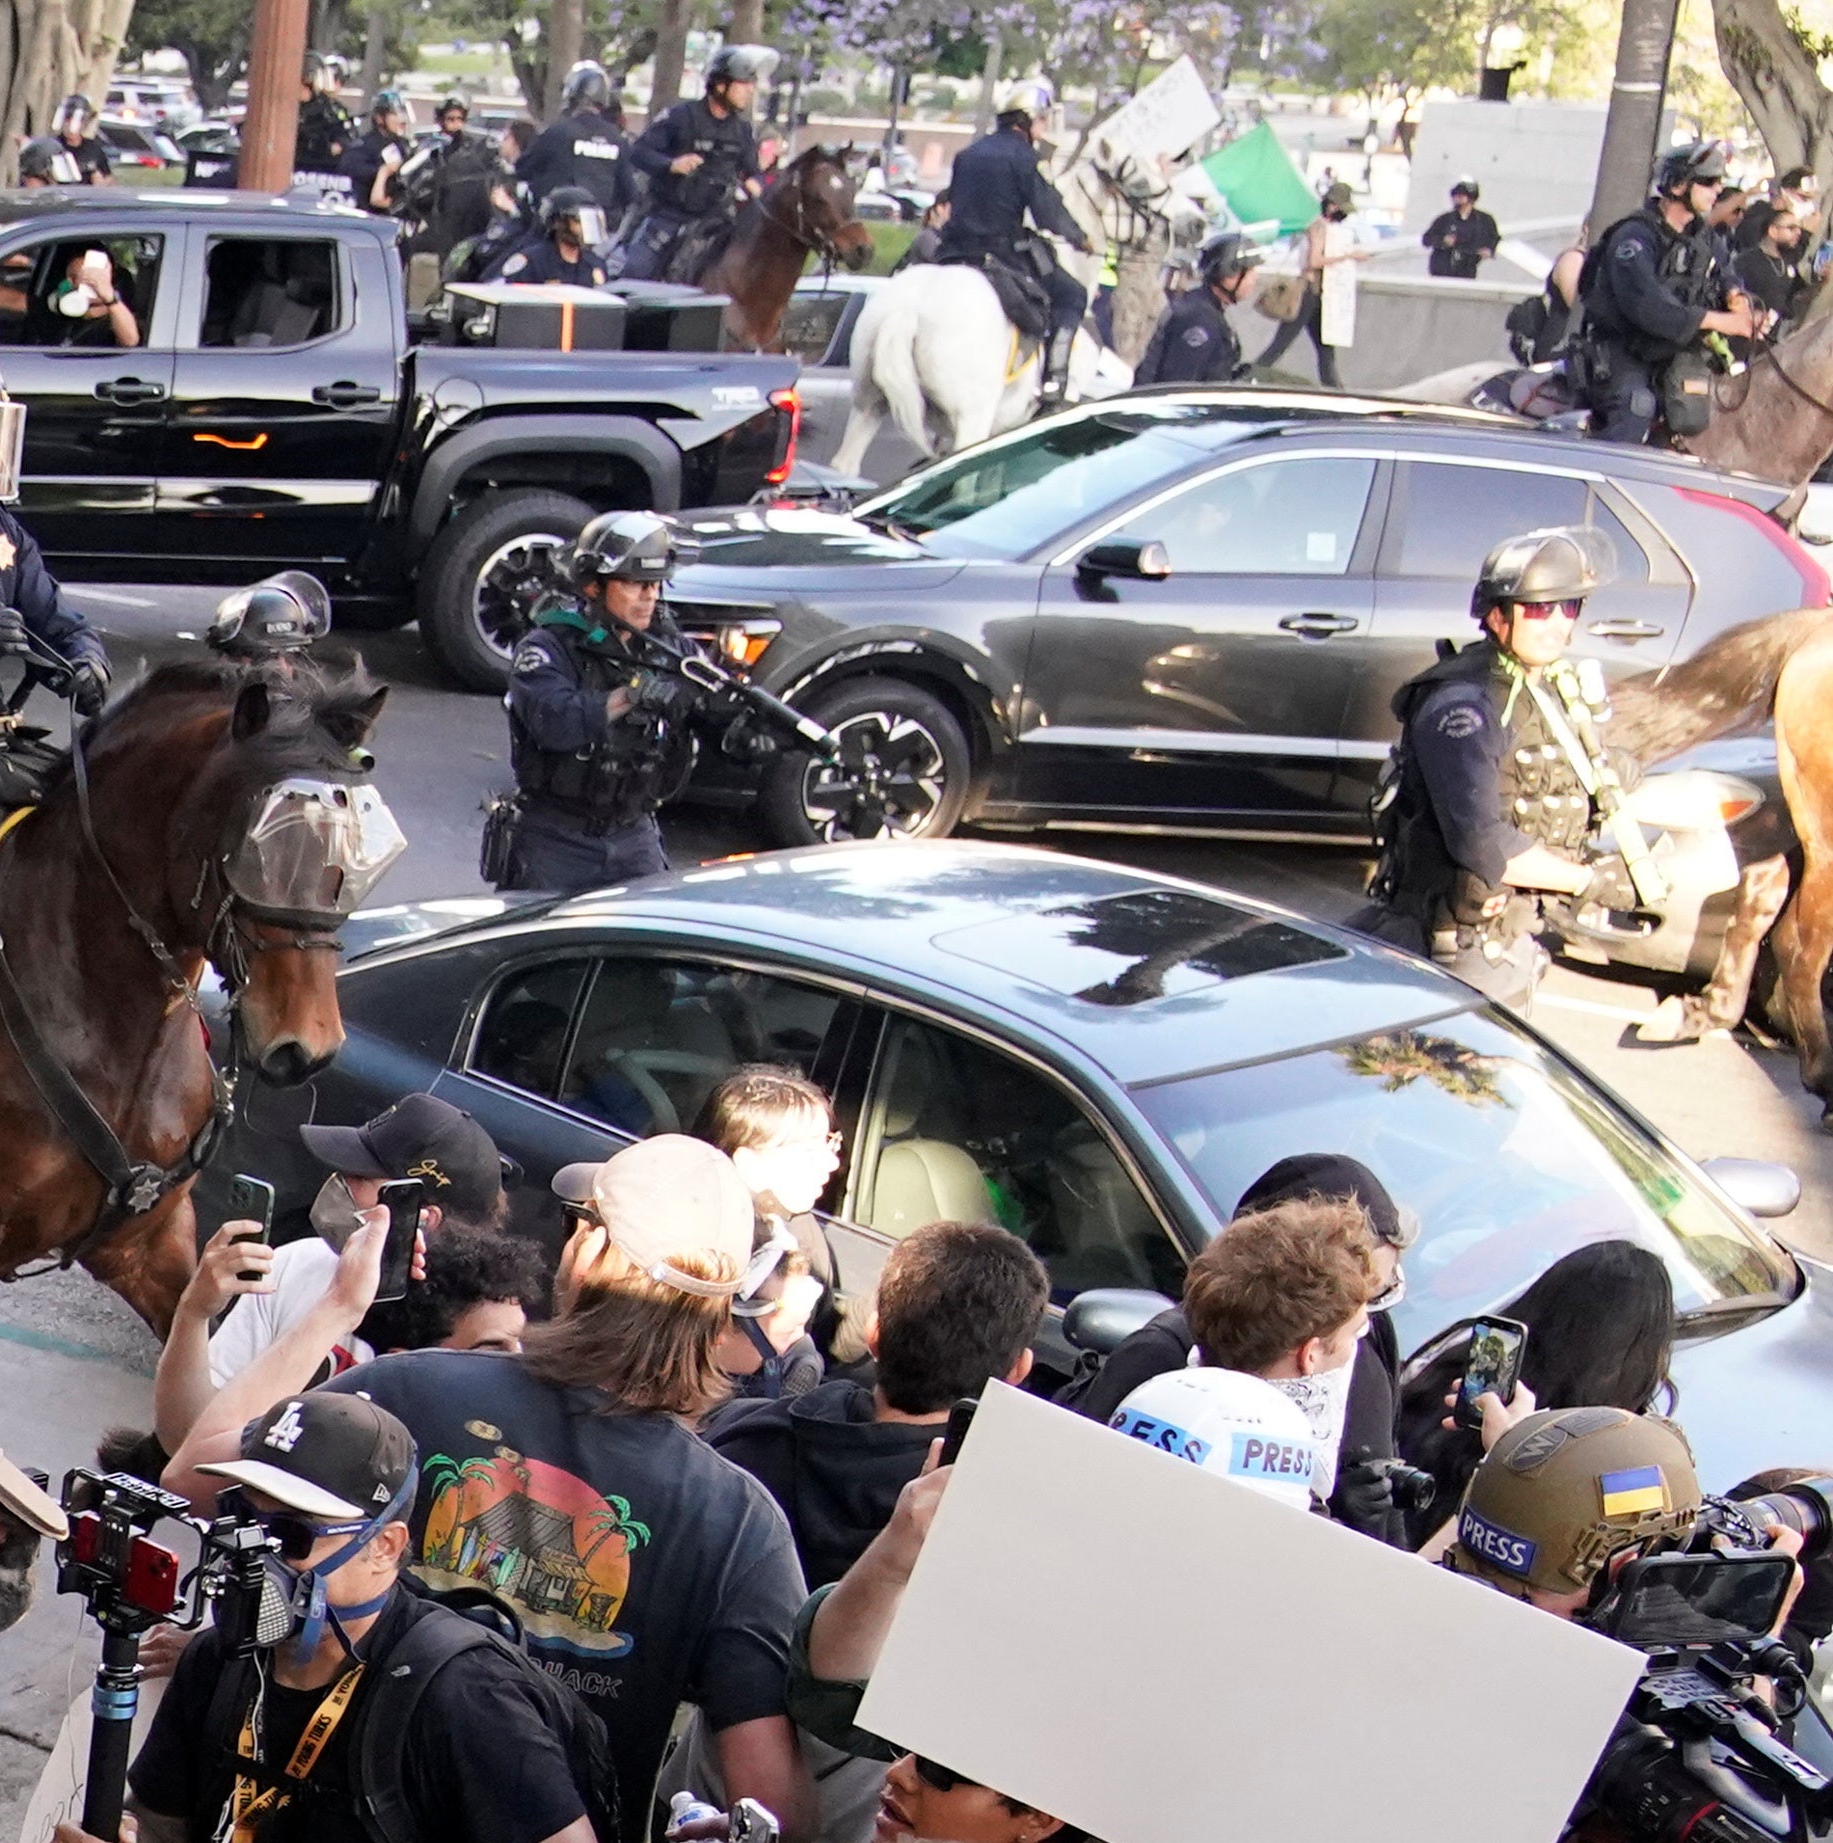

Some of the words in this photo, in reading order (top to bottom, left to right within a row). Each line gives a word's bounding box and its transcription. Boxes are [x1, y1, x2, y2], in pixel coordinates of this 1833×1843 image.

[1243, 1438, 1312, 1477] PRESS
[1462, 1513, 1526, 1567] PRESS
[308, 1713, 332, 1743] TURKS
